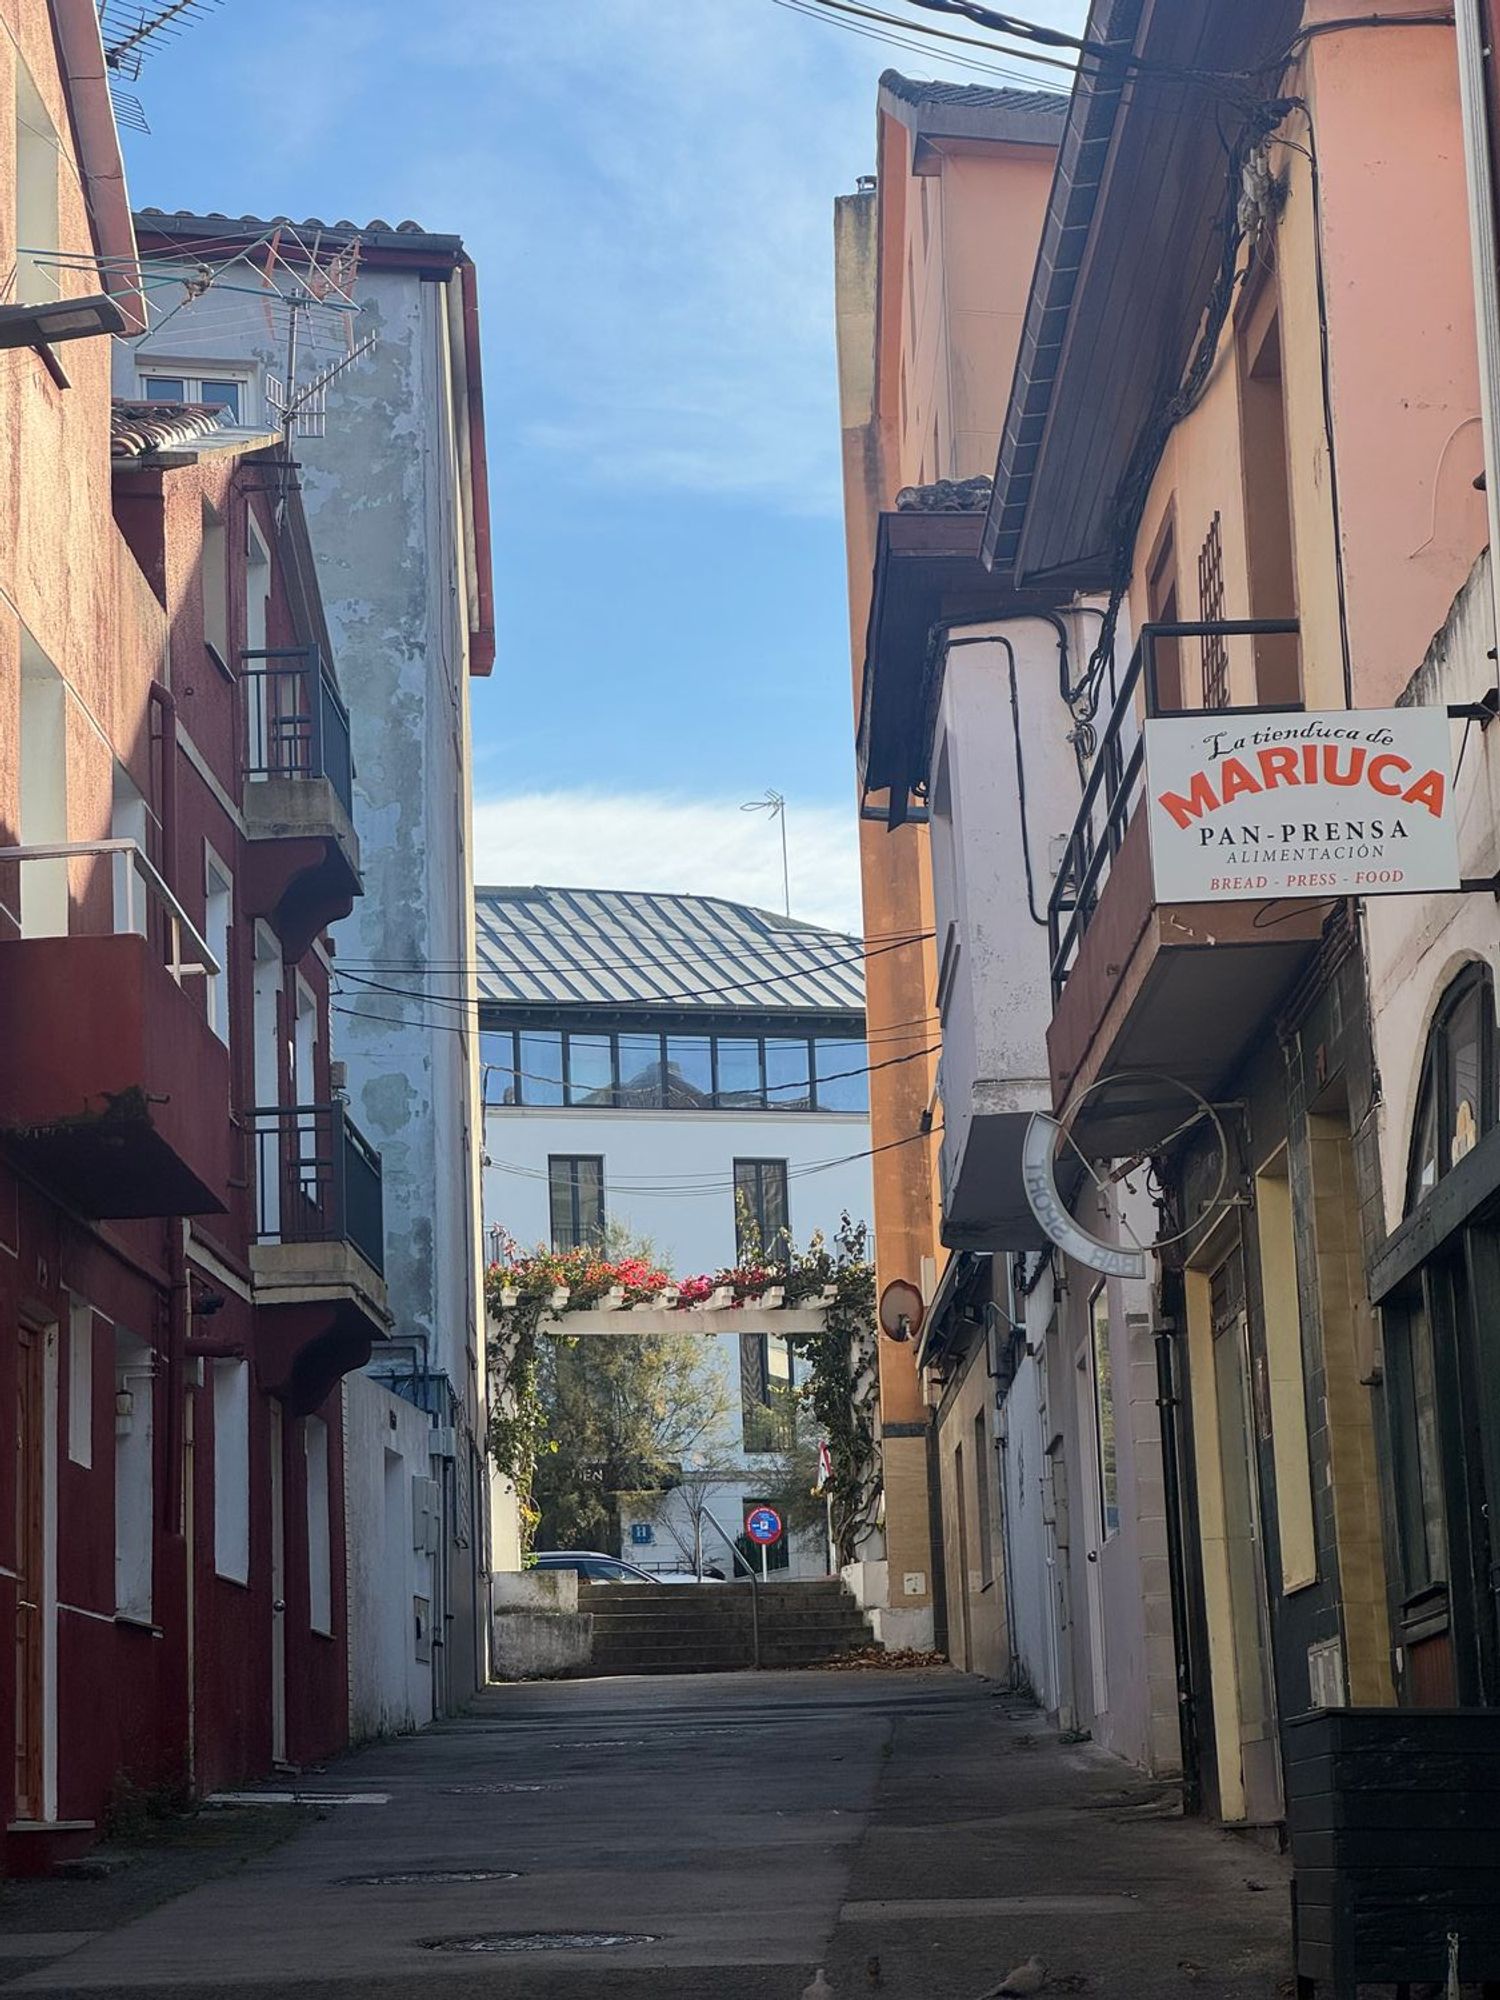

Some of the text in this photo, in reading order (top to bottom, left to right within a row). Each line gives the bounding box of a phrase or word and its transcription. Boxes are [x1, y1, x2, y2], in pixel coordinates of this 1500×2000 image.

[1203, 720, 1394, 761] La tienduca de
[1158, 744, 1446, 830] MARIUCA
[1227, 844, 1385, 864] ALIMENTACIÓN
[1210, 876, 1268, 891] BREAD
[1286, 872, 1337, 888] PRESS
[1355, 870, 1404, 884] FOOD
